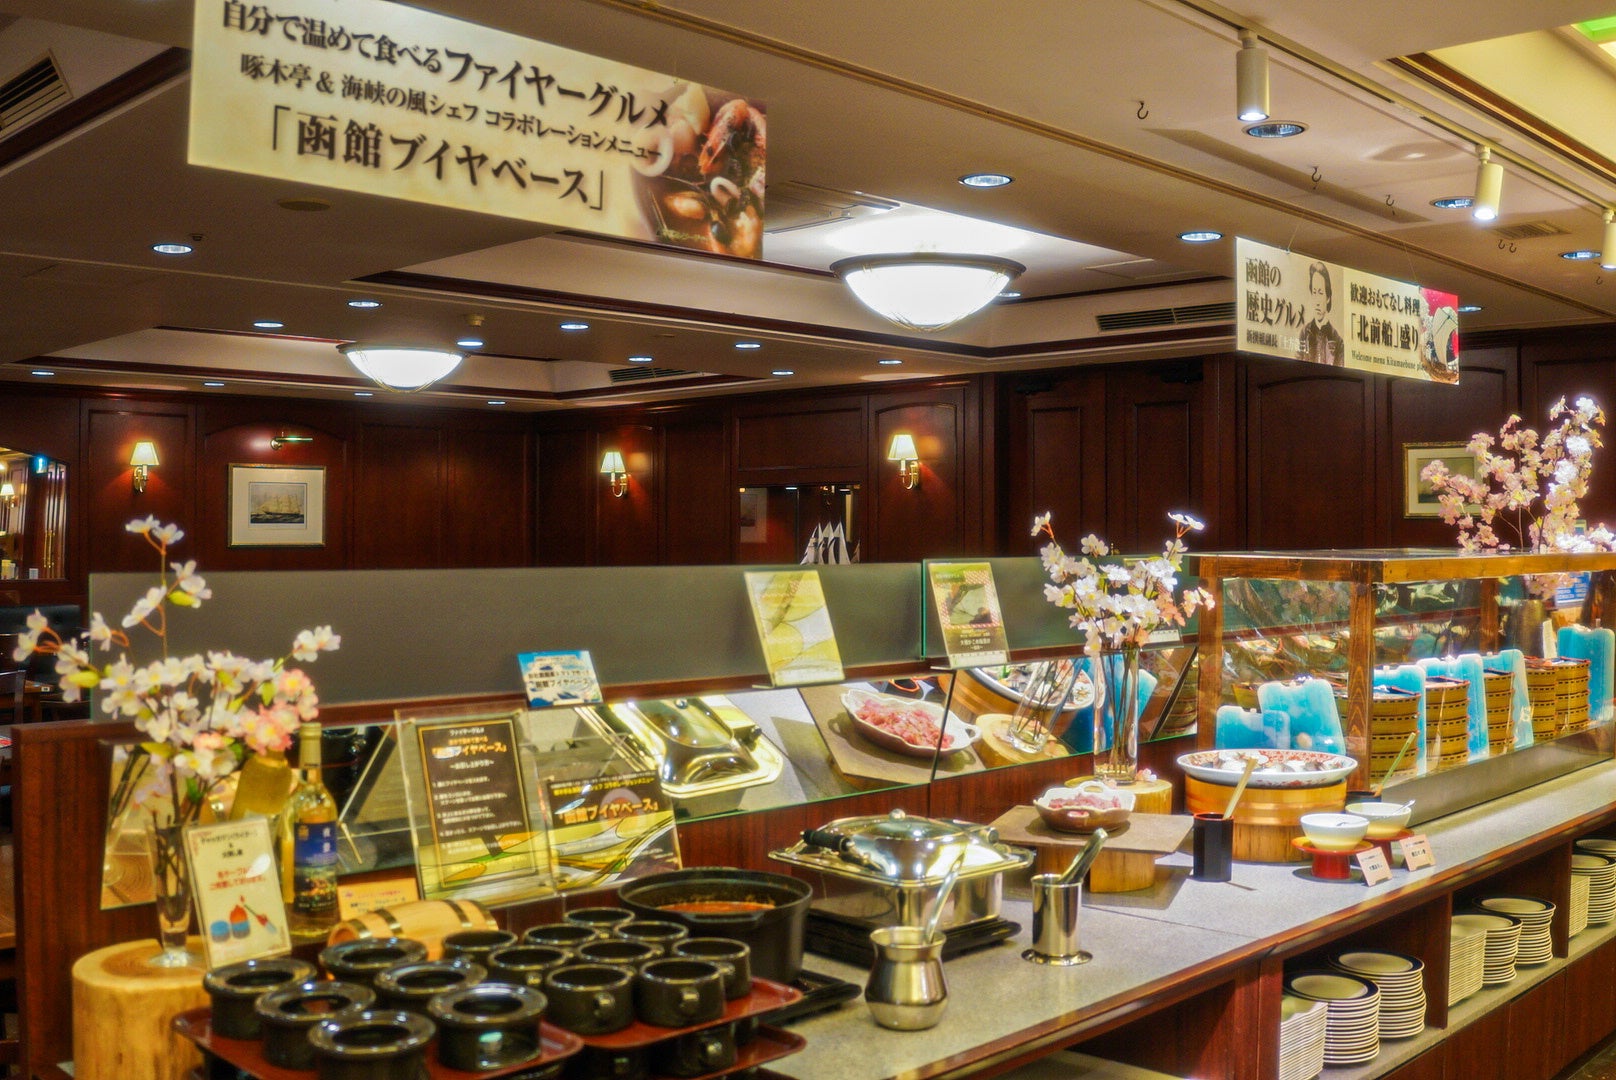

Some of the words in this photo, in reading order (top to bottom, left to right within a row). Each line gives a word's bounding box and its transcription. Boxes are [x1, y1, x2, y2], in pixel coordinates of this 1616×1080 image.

[223, 0, 670, 129] 自分で温めて食べるファイヤーグルメ
[240, 53, 312, 90] 啄木亭
[315, 71, 335, 95] &
[341, 73, 480, 122] 海峡の風シェフ
[485, 108, 664, 159] コラボレーションメニュー
[1245, 257, 1282, 288] 函館の
[1245, 290, 1305, 328] 歴史グルメ
[1351, 312, 1419, 351] 「北前船」盛り
